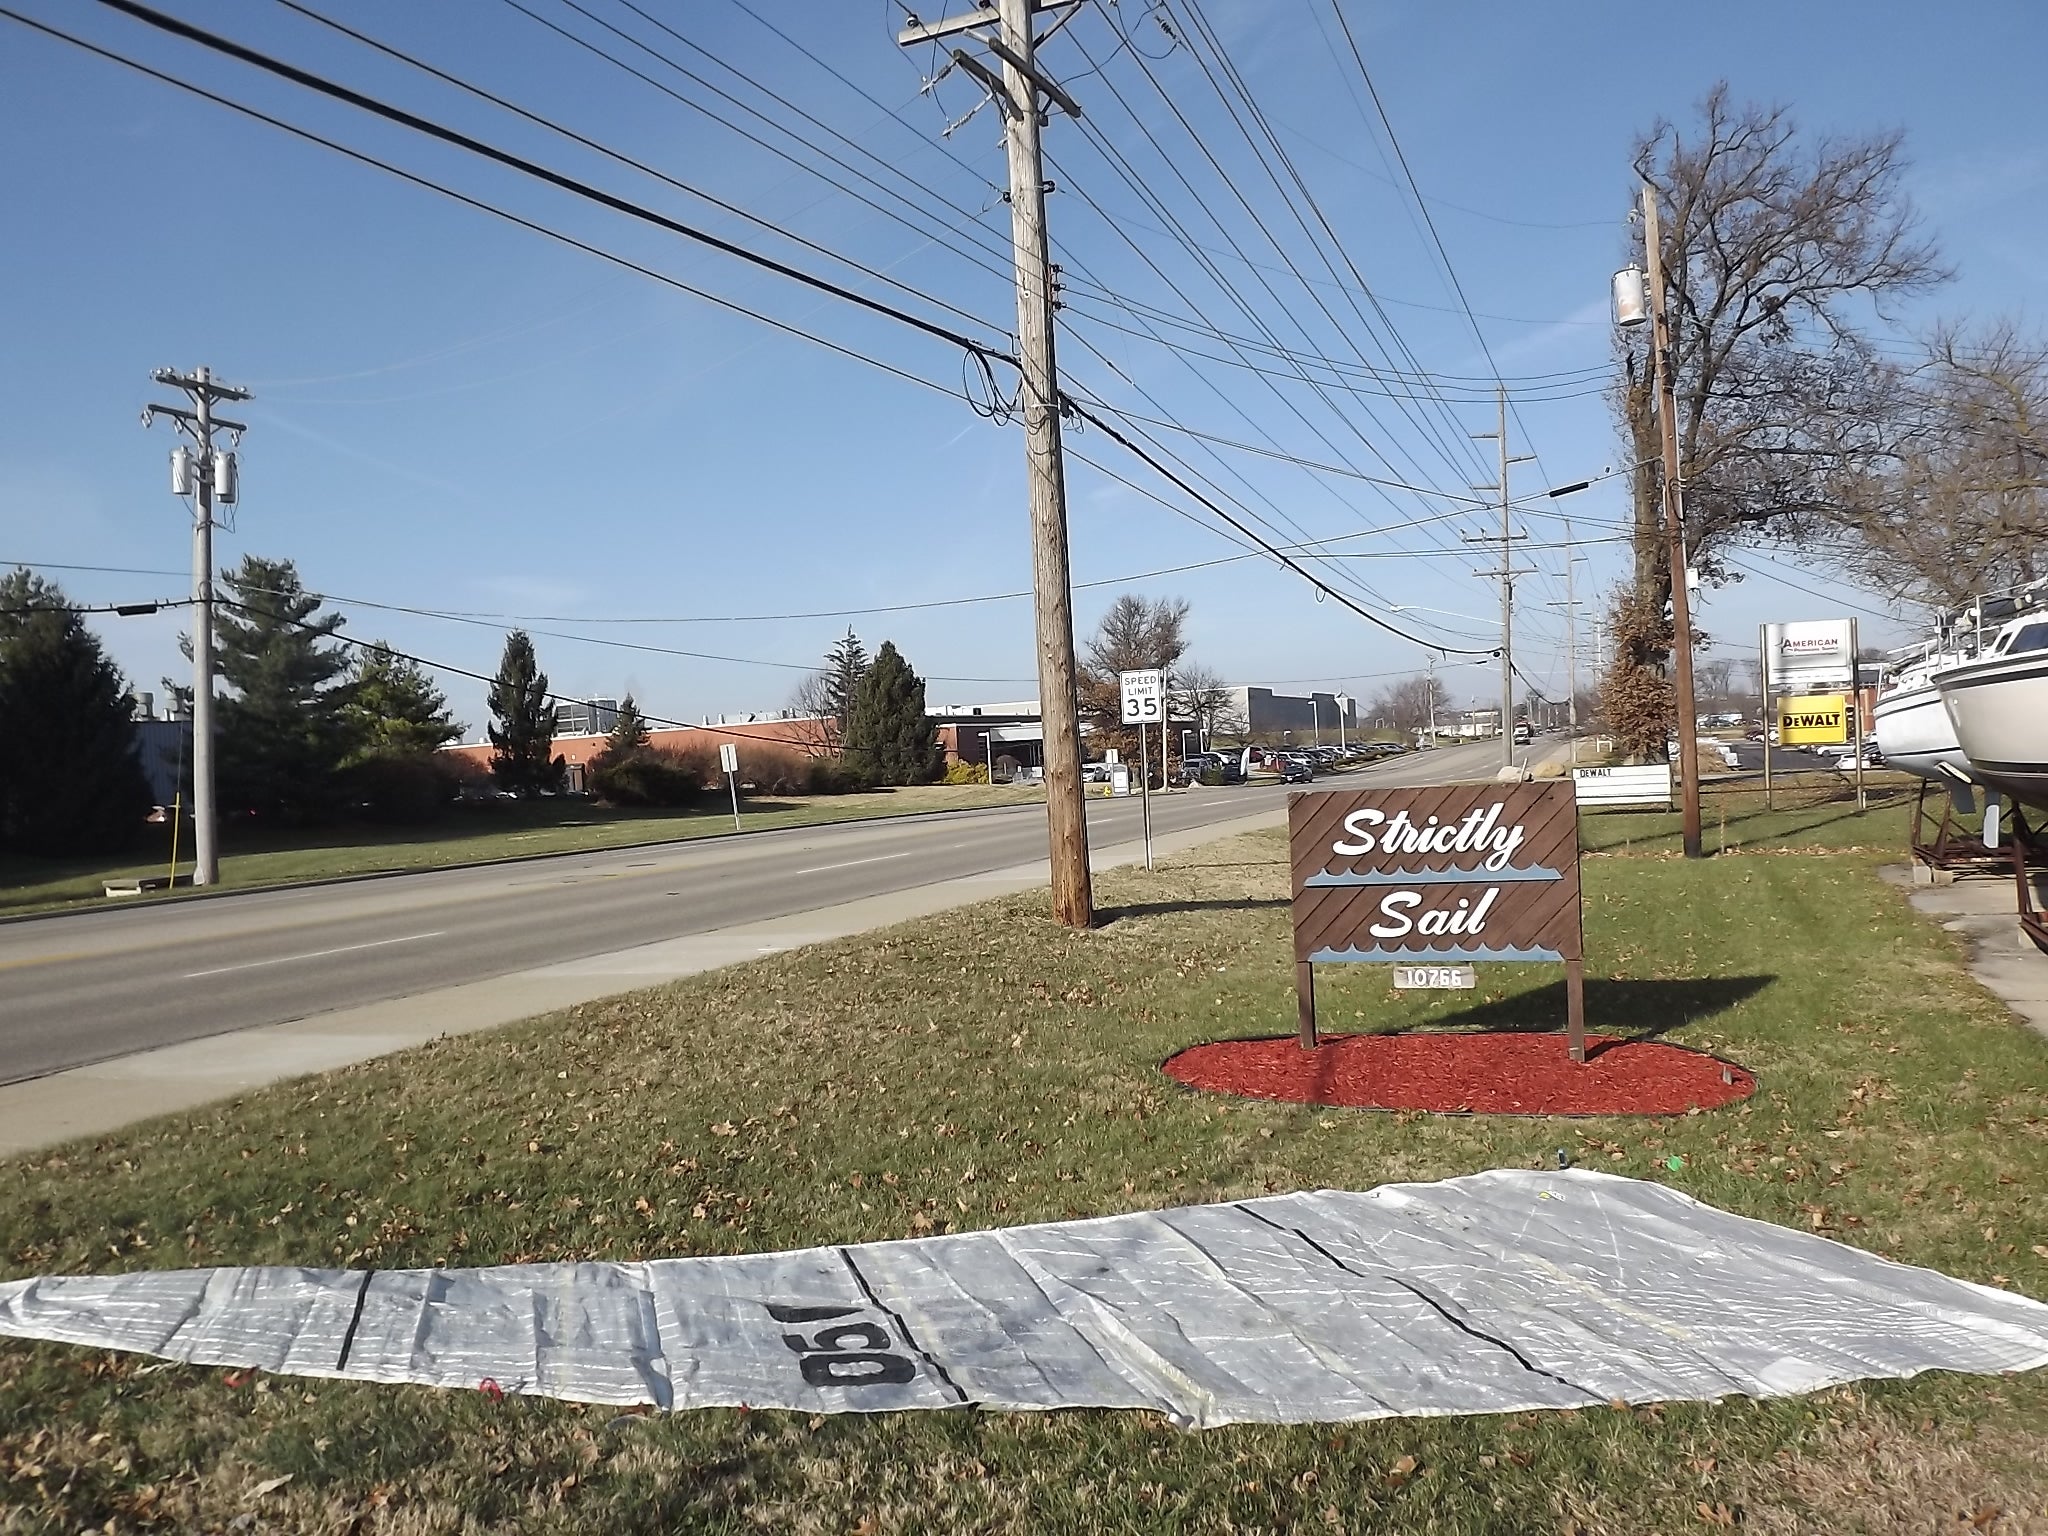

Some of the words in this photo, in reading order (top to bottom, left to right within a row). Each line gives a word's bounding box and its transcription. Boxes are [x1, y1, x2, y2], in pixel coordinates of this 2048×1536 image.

[1783, 639, 1838, 648] AMERICAN
[1125, 676, 1156, 685] SPEED
[1128, 686, 1153, 696] LIMIT
[1127, 697, 1157, 717] 35
[1580, 768, 1612, 778] DEWALT
[1332, 802, 1525, 872] Strictly
[1369, 887, 1501, 939] Sail
[1407, 968, 1462, 987] 10766
